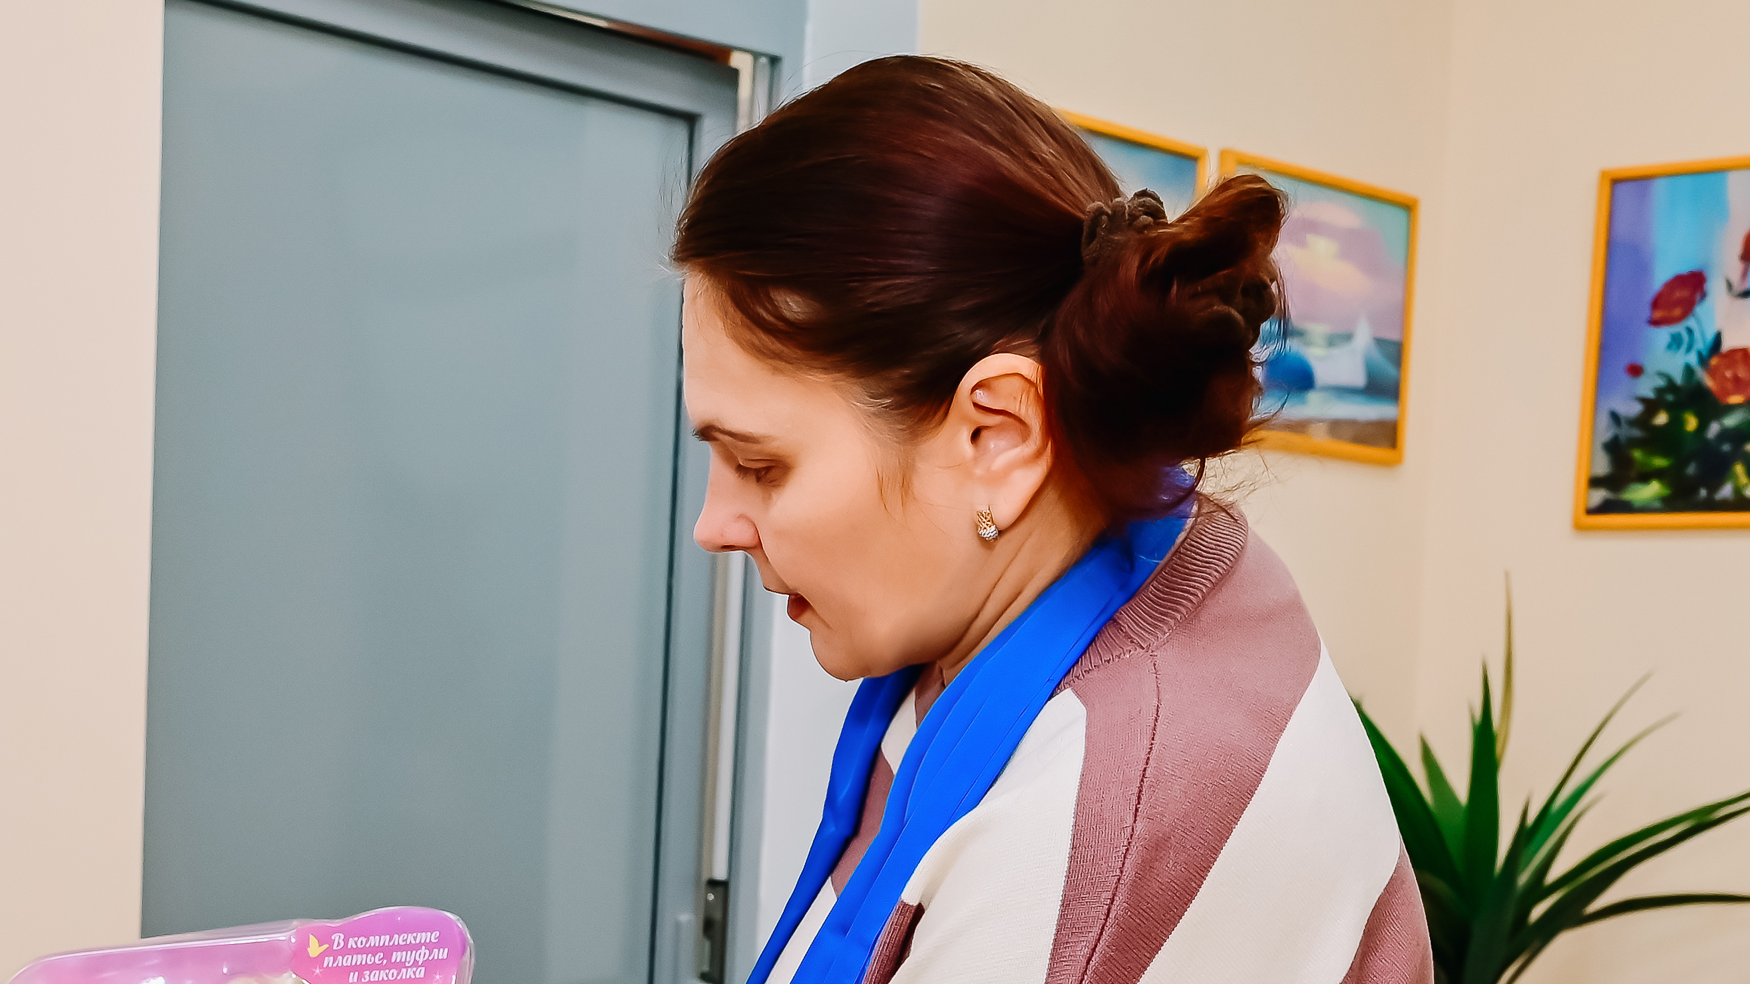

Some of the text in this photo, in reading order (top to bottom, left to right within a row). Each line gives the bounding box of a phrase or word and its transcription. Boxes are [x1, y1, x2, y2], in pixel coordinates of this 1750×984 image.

[331, 931, 440, 950] В комплекте
[323, 945, 448, 968] платье, туфли
[348, 967, 425, 983] и заколка
